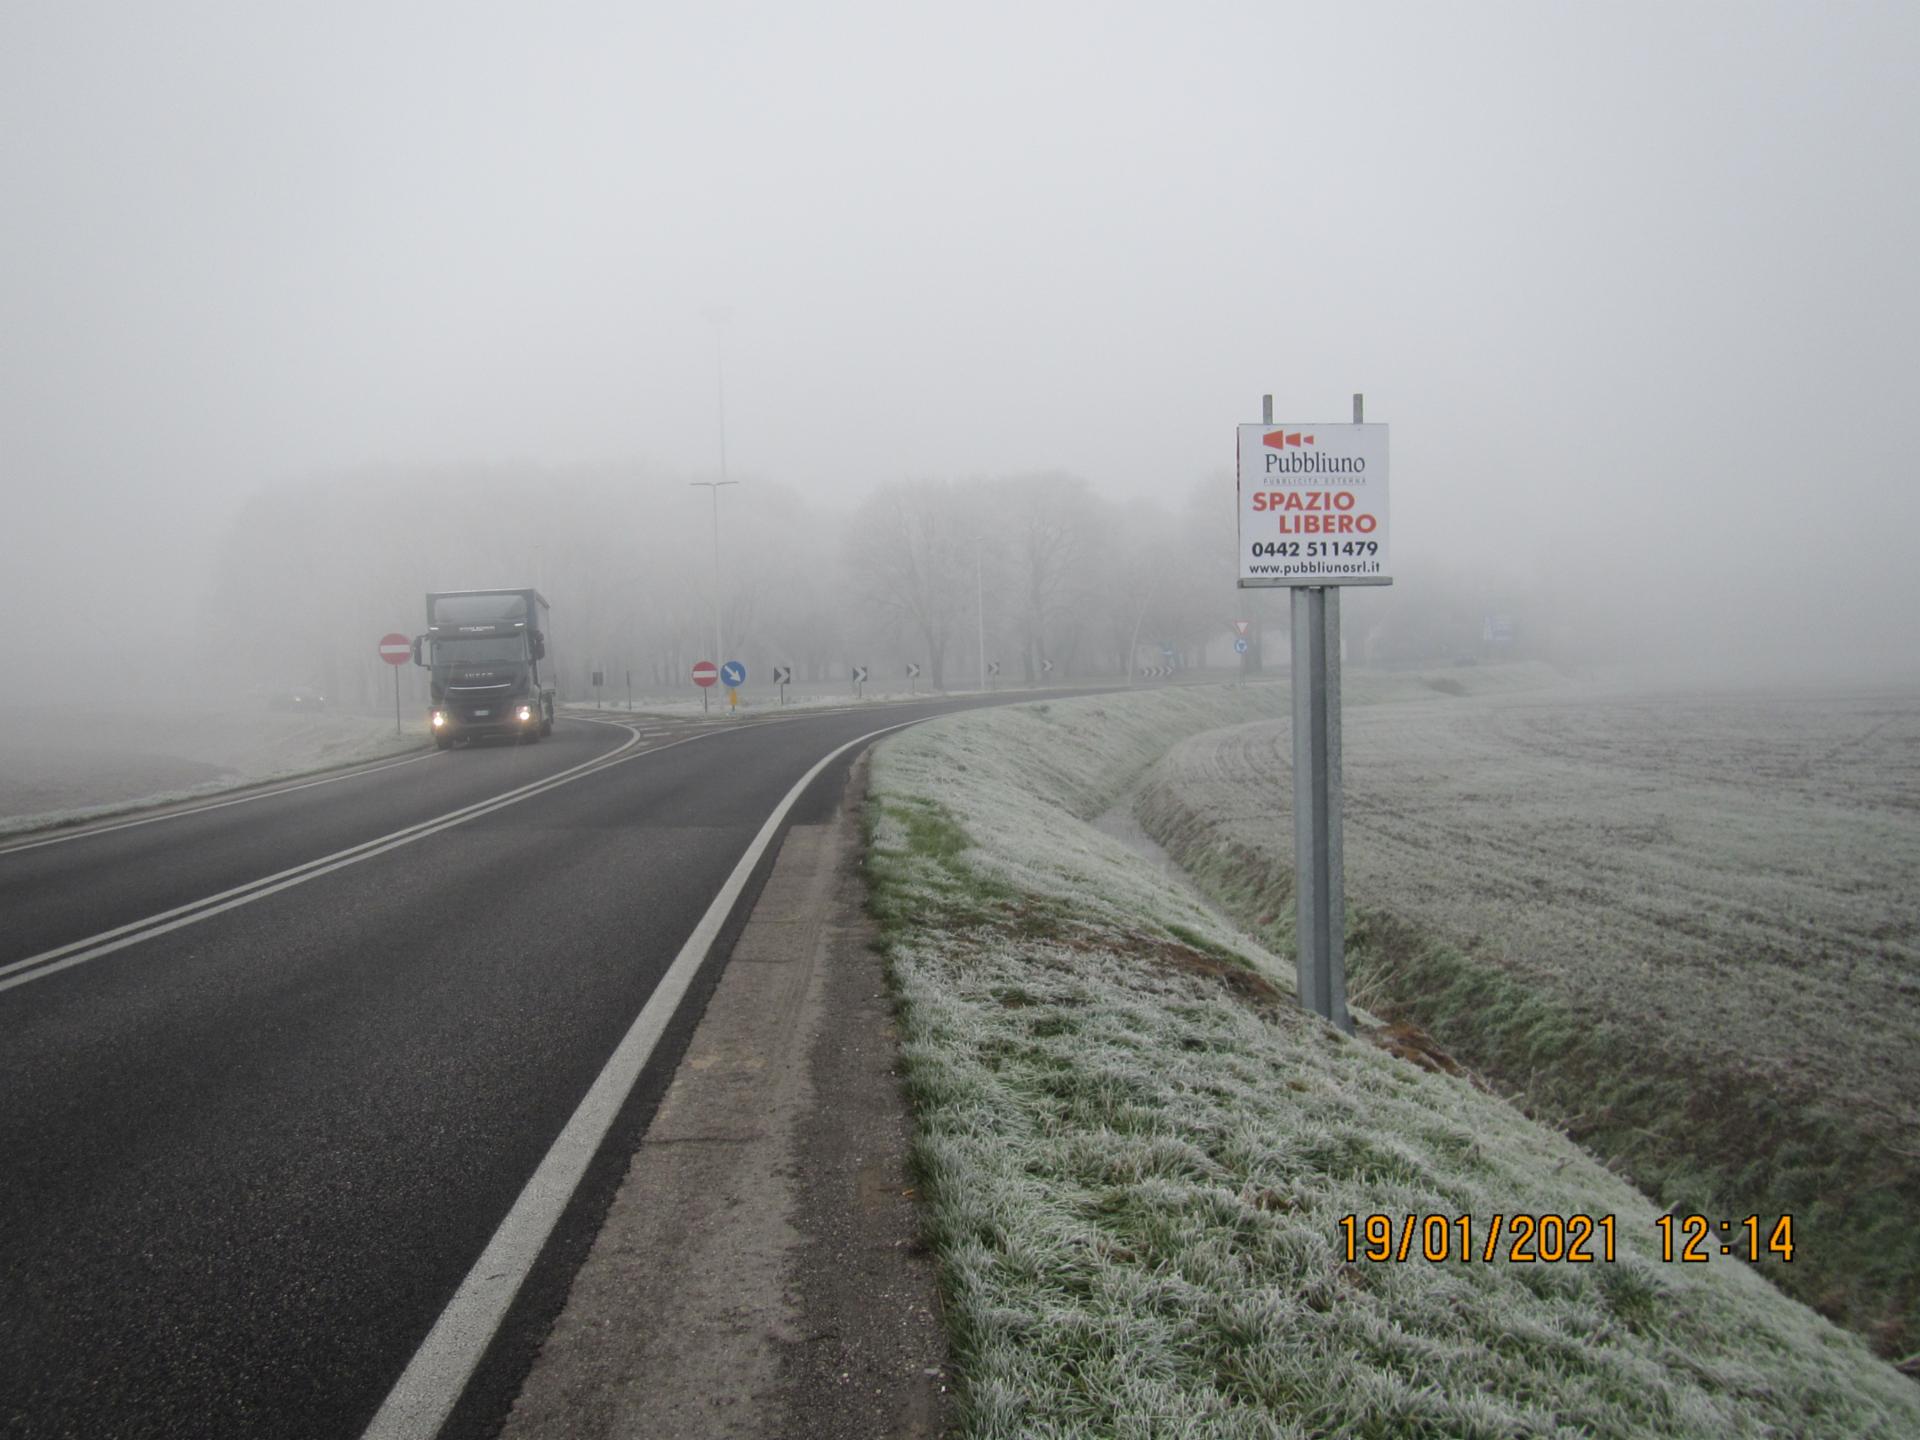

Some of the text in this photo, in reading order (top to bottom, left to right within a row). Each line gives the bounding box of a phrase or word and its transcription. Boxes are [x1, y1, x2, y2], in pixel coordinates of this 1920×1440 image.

[1264, 451, 1366, 473] Pubbliuno
[1252, 491, 1355, 511] SPAZIO
[1279, 514, 1377, 534] LIBERO
[1252, 541, 1378, 557] 0442 511479
[1249, 561, 1380, 576] www.pubbliunosrl.it
